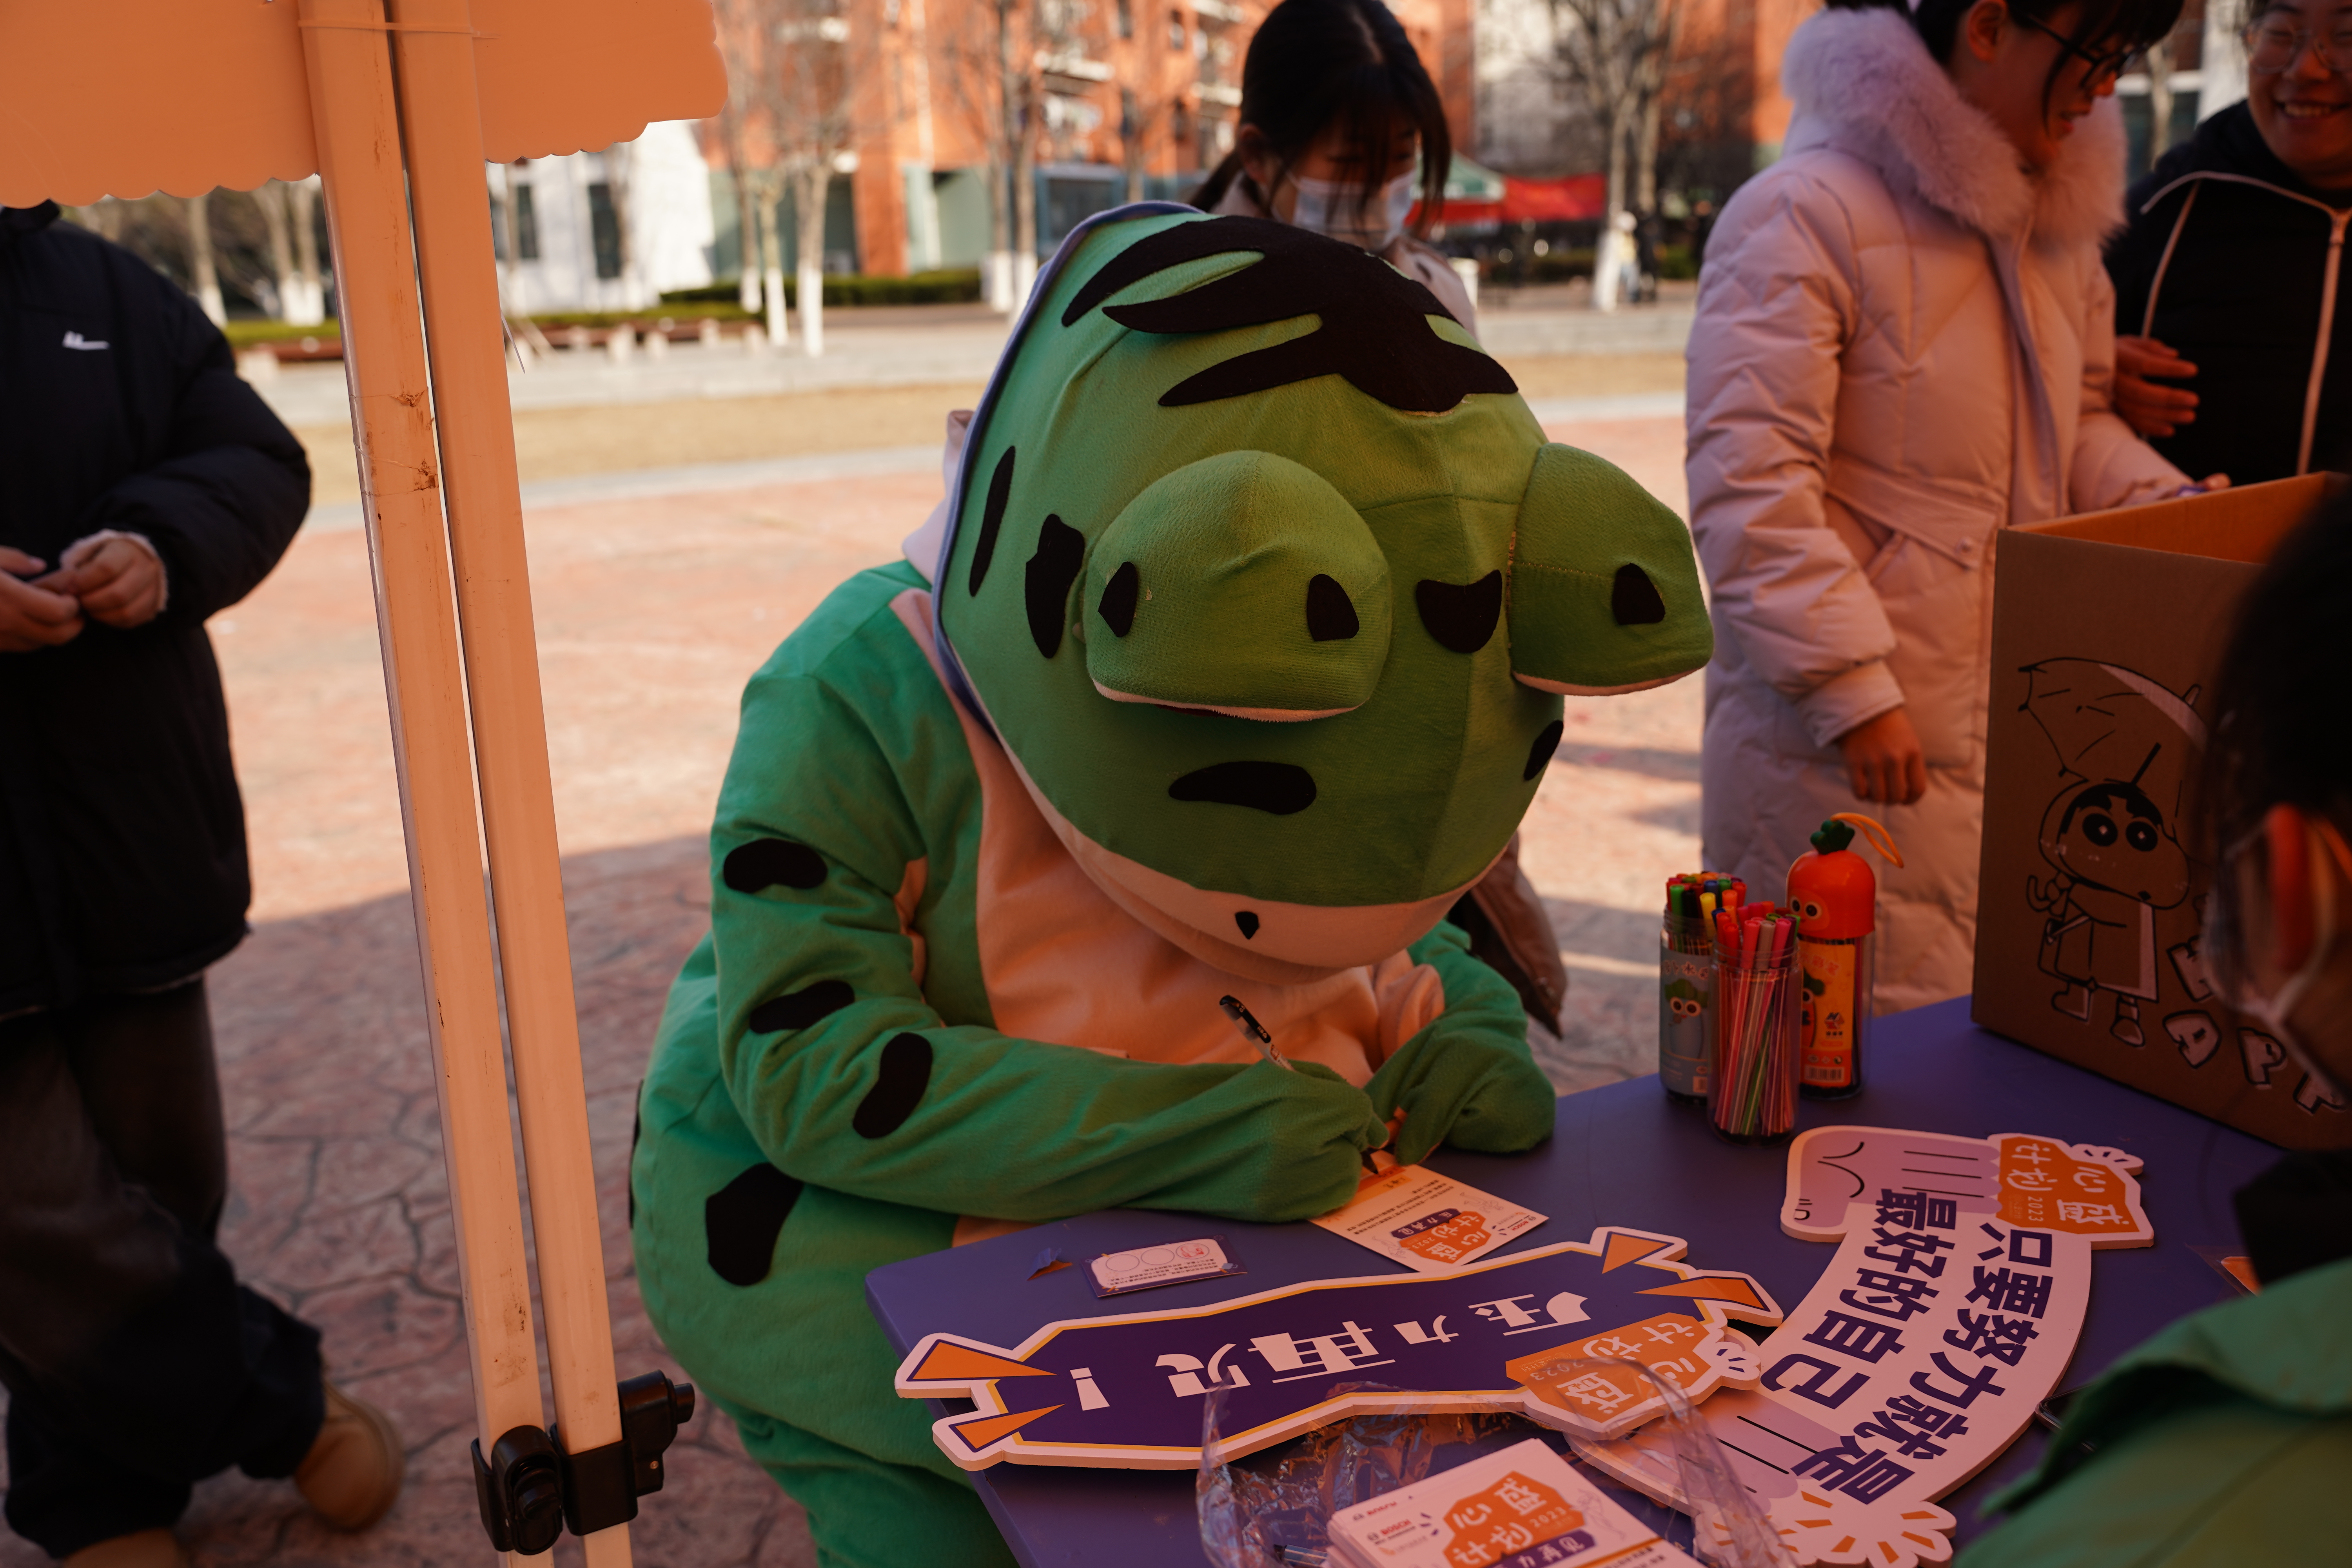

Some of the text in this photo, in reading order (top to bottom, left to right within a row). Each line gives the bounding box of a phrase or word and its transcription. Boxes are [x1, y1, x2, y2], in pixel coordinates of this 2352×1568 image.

[2007, 1143, 2058, 1191] 计划
[2028, 1196, 2043, 1221] 2023
[1397, 1211, 1452, 1236] 压力再见
[1431, 1214, 1481, 1238] 计划
[1511, 1220, 1528, 1230] BOSCH
[1412, 1236, 1436, 1249] 2023
[1760, 1189, 1956, 1410] 最好的自己
[1530, 1322, 1695, 1380] 计划 2023
[1790, 1222, 2053, 1505] 只要努力就是
[1380, 1519, 1411, 1535] BOSCH
[1454, 1522, 1534, 1564] 计划
[1529, 1506, 1567, 1528] 2023
[1492, 1536, 1586, 1568] 力再见
